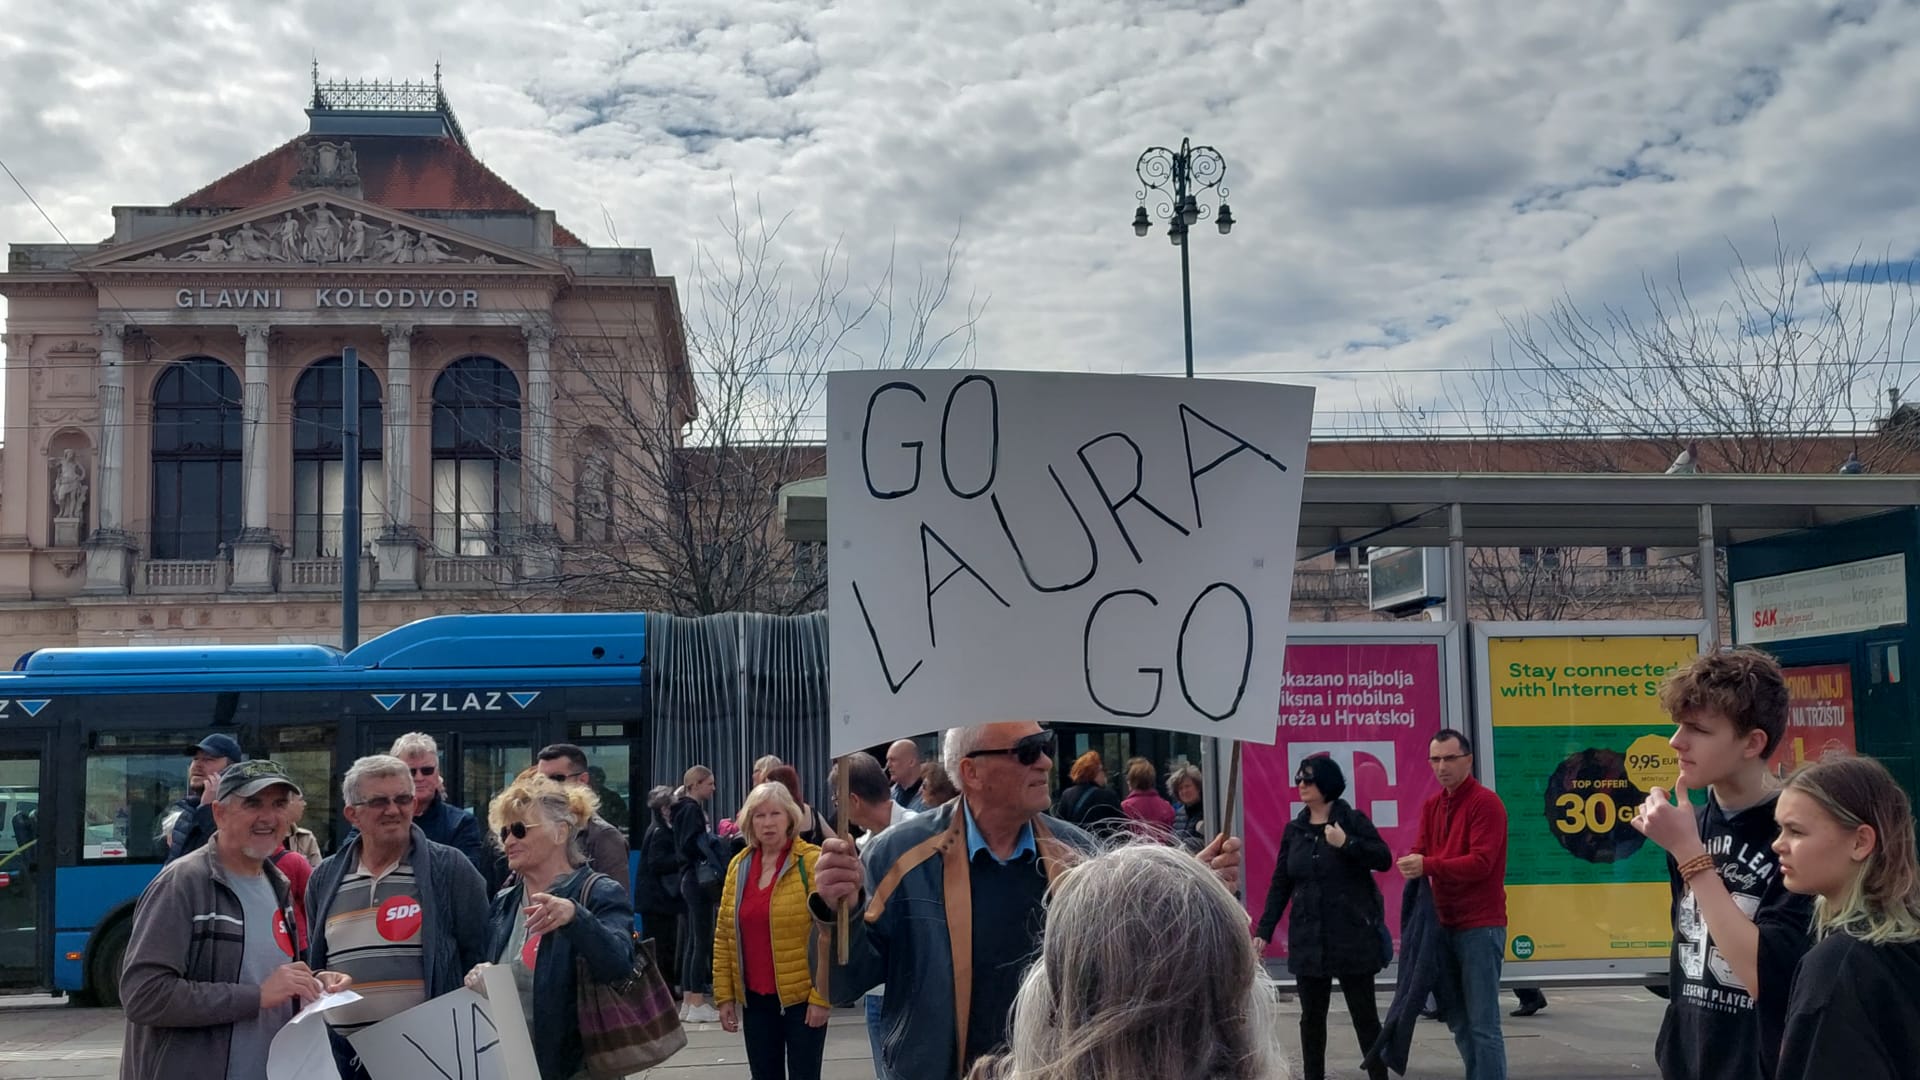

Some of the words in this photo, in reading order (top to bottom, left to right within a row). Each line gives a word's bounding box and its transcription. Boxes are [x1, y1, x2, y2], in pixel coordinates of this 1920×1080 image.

[176, 289, 281, 307] GLAVNI
[316, 289, 479, 307] KOLODVOR
[862, 375, 999, 500] GO
[852, 402, 1287, 694] LAURA
[1084, 582, 1253, 721] GO
[1349, 670, 1414, 689] najbolja
[1509, 663, 1556, 681] Stay
[1500, 682, 1546, 697] with
[1552, 682, 1637, 696] Internet
[1784, 674, 1843, 698] OVOLJNIJI
[410, 692, 502, 711] IZLAZ
[1328, 690, 1332, 706] i
[1336, 691, 1404, 706] mobilna
[1278, 709, 1316, 726] reža
[1321, 713, 1330, 726] u
[1335, 709, 1415, 728] Hrvatskoj
[1806, 701, 1845, 727] TRŽIŠTU
[1629, 755, 1660, 771] 9,95
[1572, 780, 1591, 788] TOP
[1594, 780, 1628, 788] OFFER!
[1555, 793, 1616, 833] 30
[1738, 843, 1774, 880] LEA
[385, 904, 421, 921] SDP
[1711, 990, 1754, 1010] PLAYER
